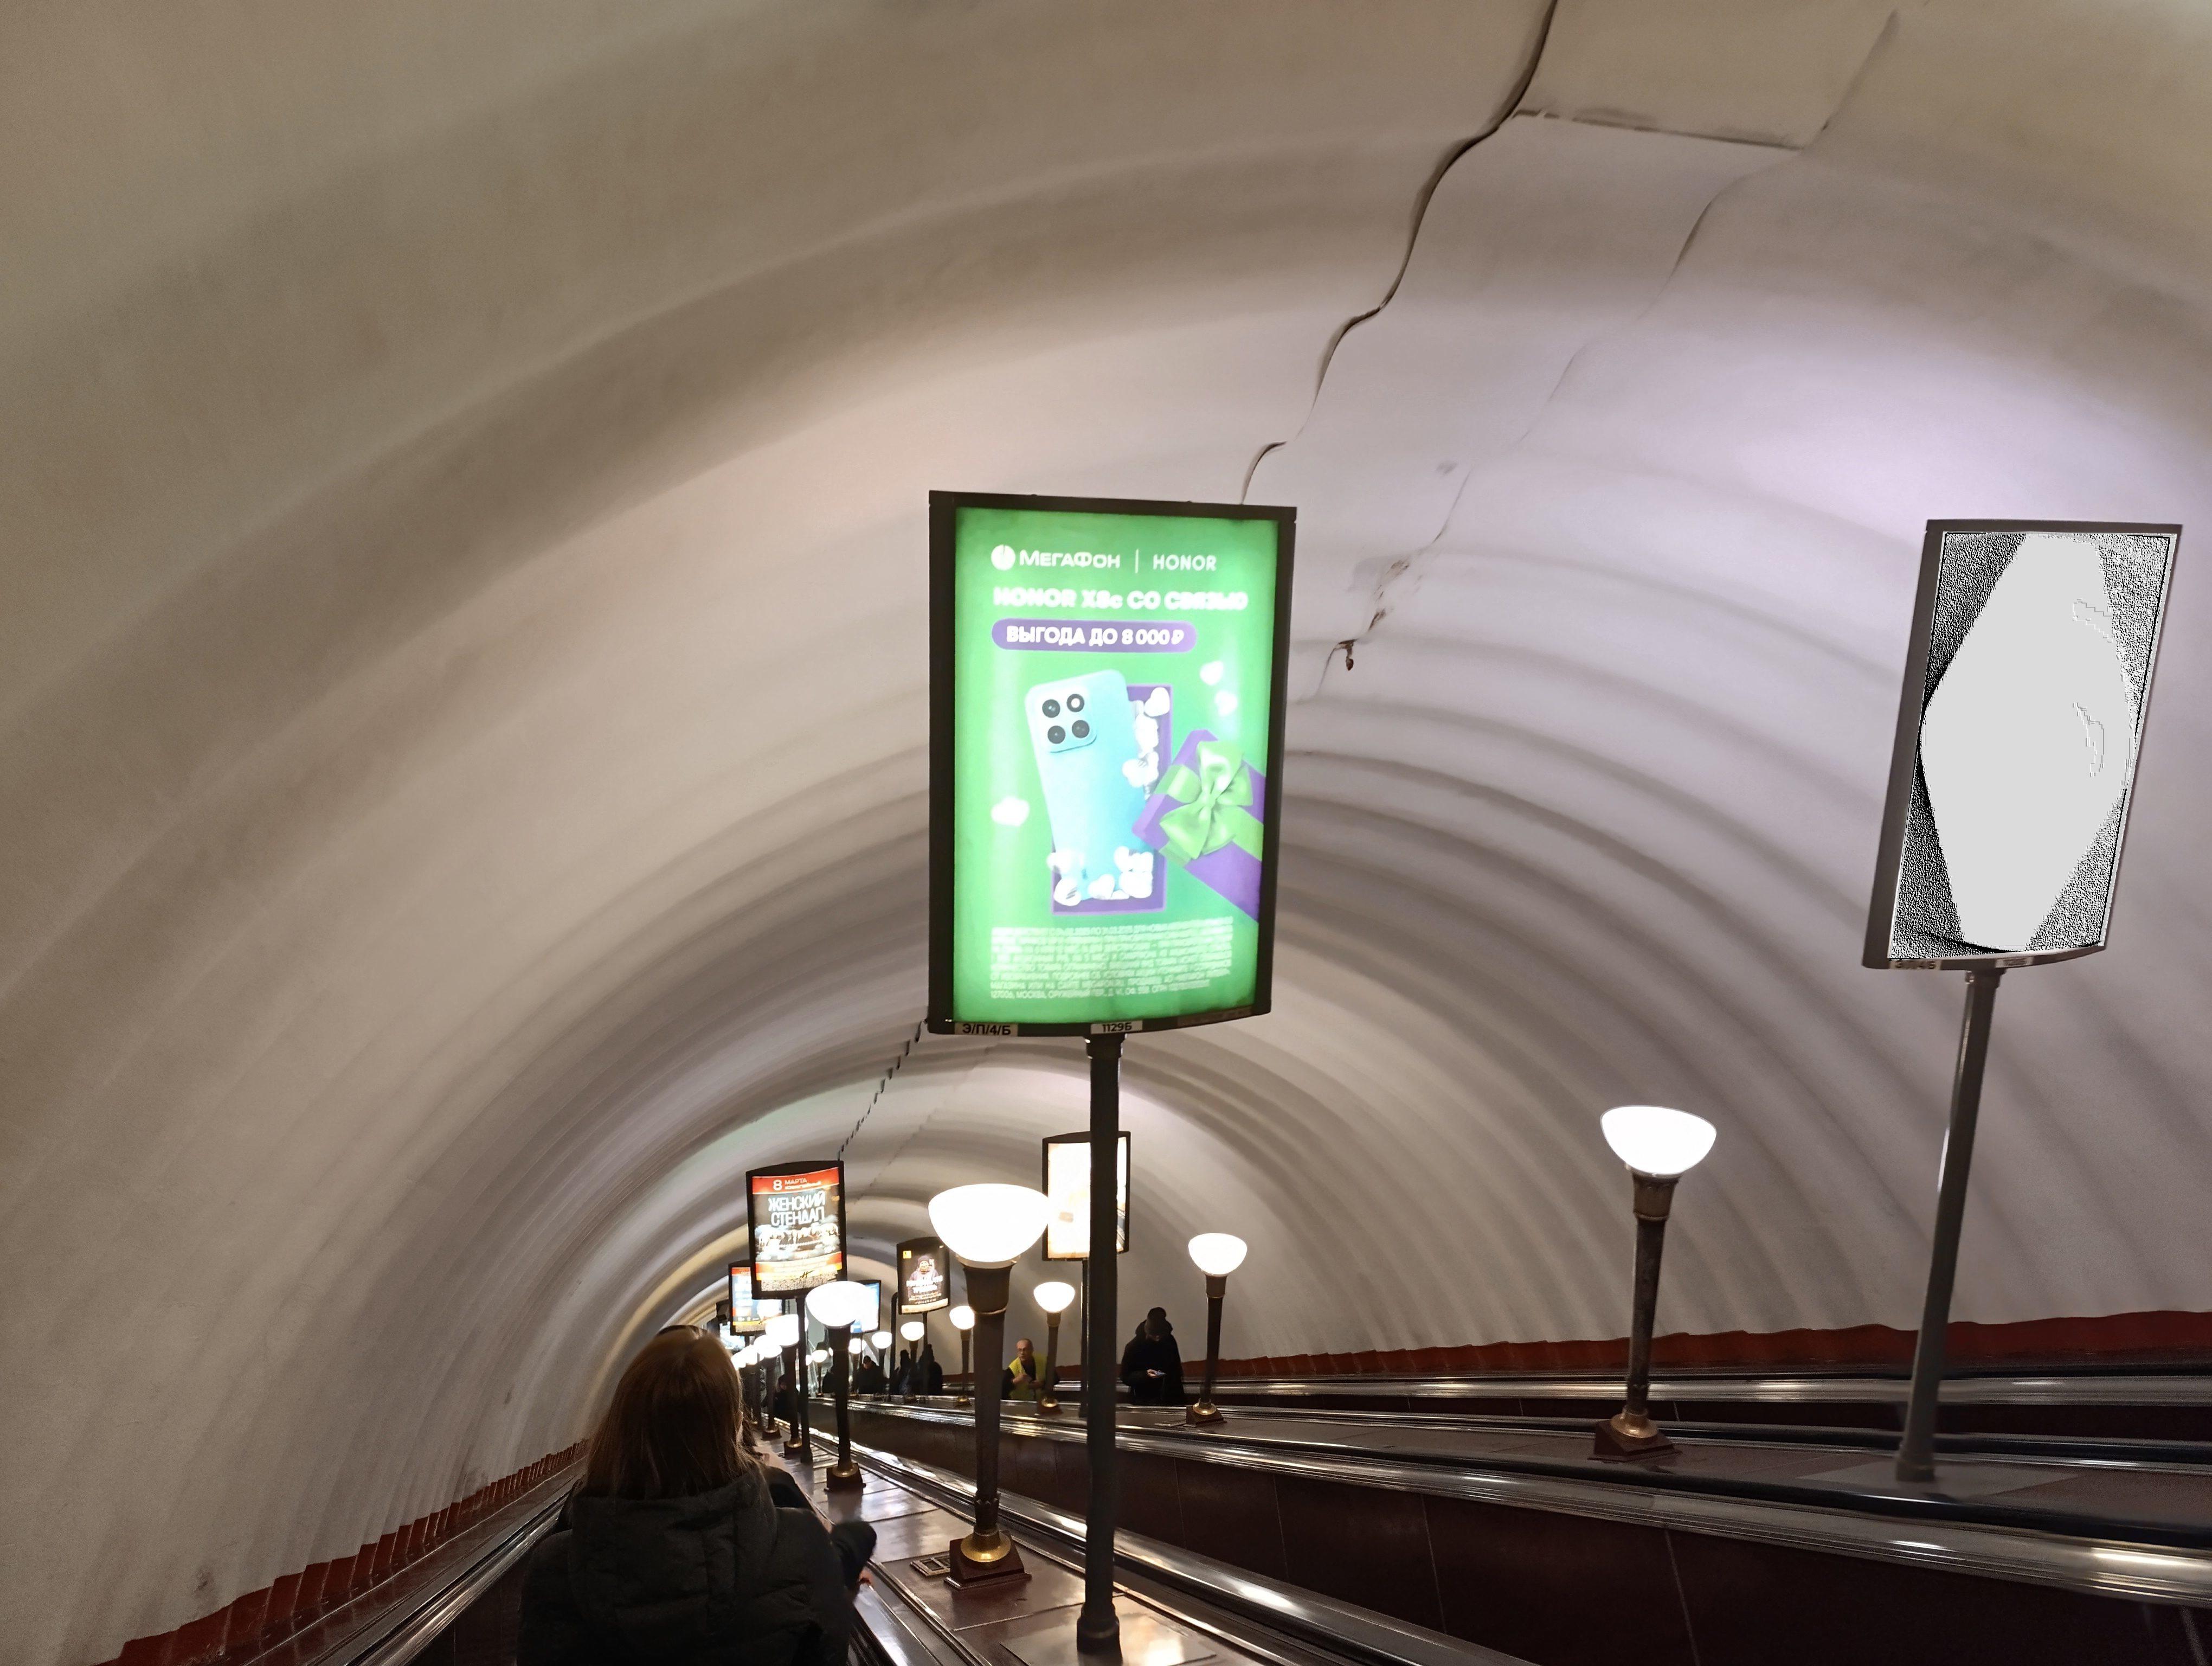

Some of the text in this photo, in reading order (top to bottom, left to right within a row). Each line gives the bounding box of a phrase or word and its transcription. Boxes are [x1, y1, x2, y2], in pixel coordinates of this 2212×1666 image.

[1153, 554, 1217, 571] HONOR
[994, 587, 1076, 607] HONOR
[1127, 591, 1161, 610] СО
[1007, 626, 1085, 646] ВЫГОДА
[1089, 628, 1118, 646] ДО
[962, 1023, 1011, 1035] Э/П/4/Б
[773, 1179, 782, 1191] 8
[768, 1190, 826, 1212] ЖЕНСКИЙ
[771, 1206, 825, 1226] СТЕНДАП
